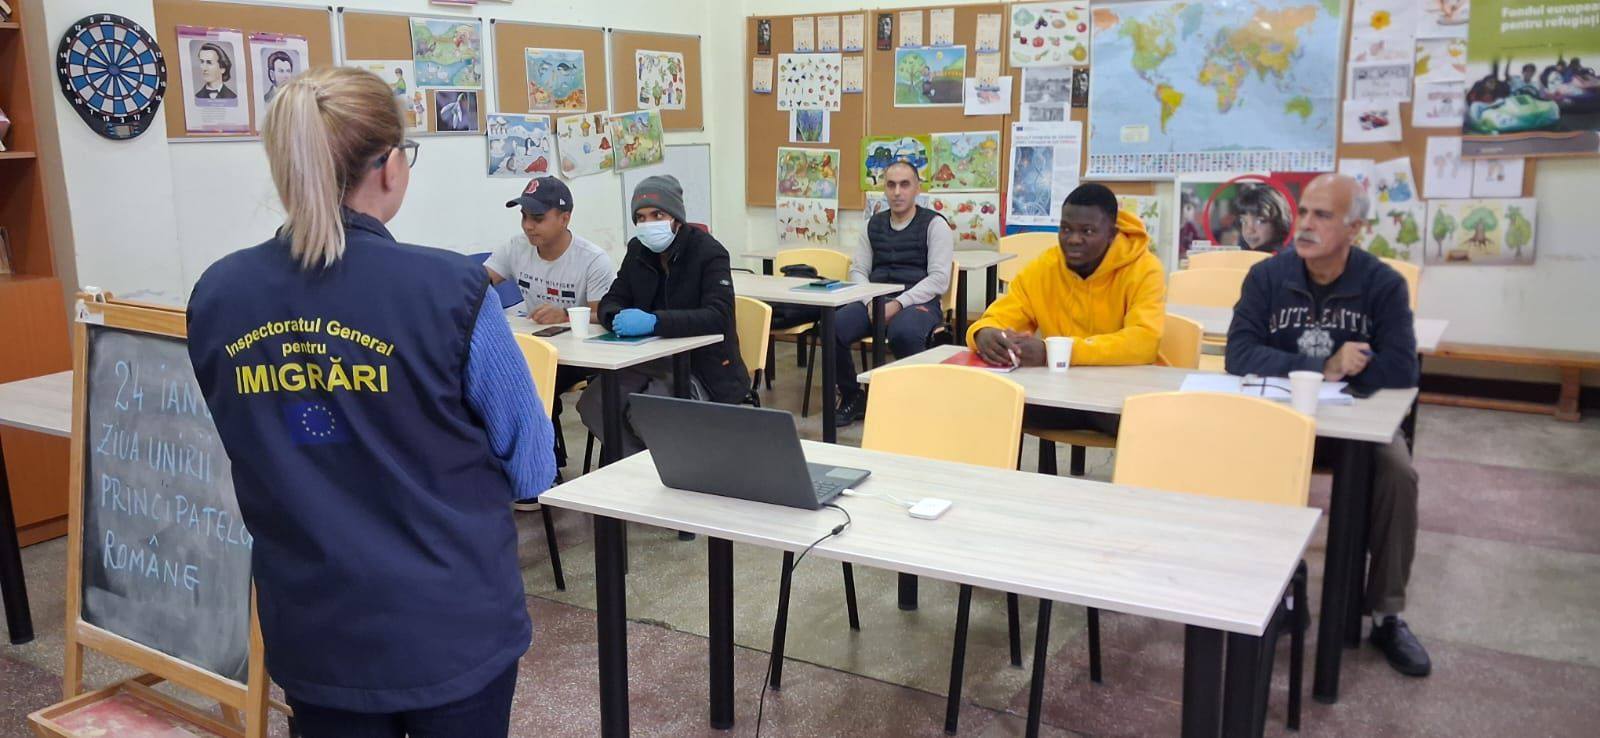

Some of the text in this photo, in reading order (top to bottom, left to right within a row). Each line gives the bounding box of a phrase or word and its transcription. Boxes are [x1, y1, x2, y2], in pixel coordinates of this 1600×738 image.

[1501, 5, 1544, 17] Fondul
[1501, 18, 1543, 33] pentru
[525, 179, 539, 194] B
[519, 271, 575, 289] TOMMY HILFIGER
[225, 317, 395, 358] Inspectoratul General
[1269, 307, 1372, 338] AUTENTI
[281, 341, 327, 357] pentru
[114, 360, 144, 412] 24
[235, 356, 389, 395] IMIGRĂRI
[96, 423, 211, 483] ZIUA UNIRII
[101, 473, 253, 549] PRINCIPATELO
[103, 529, 200, 591] ROMÂNE
